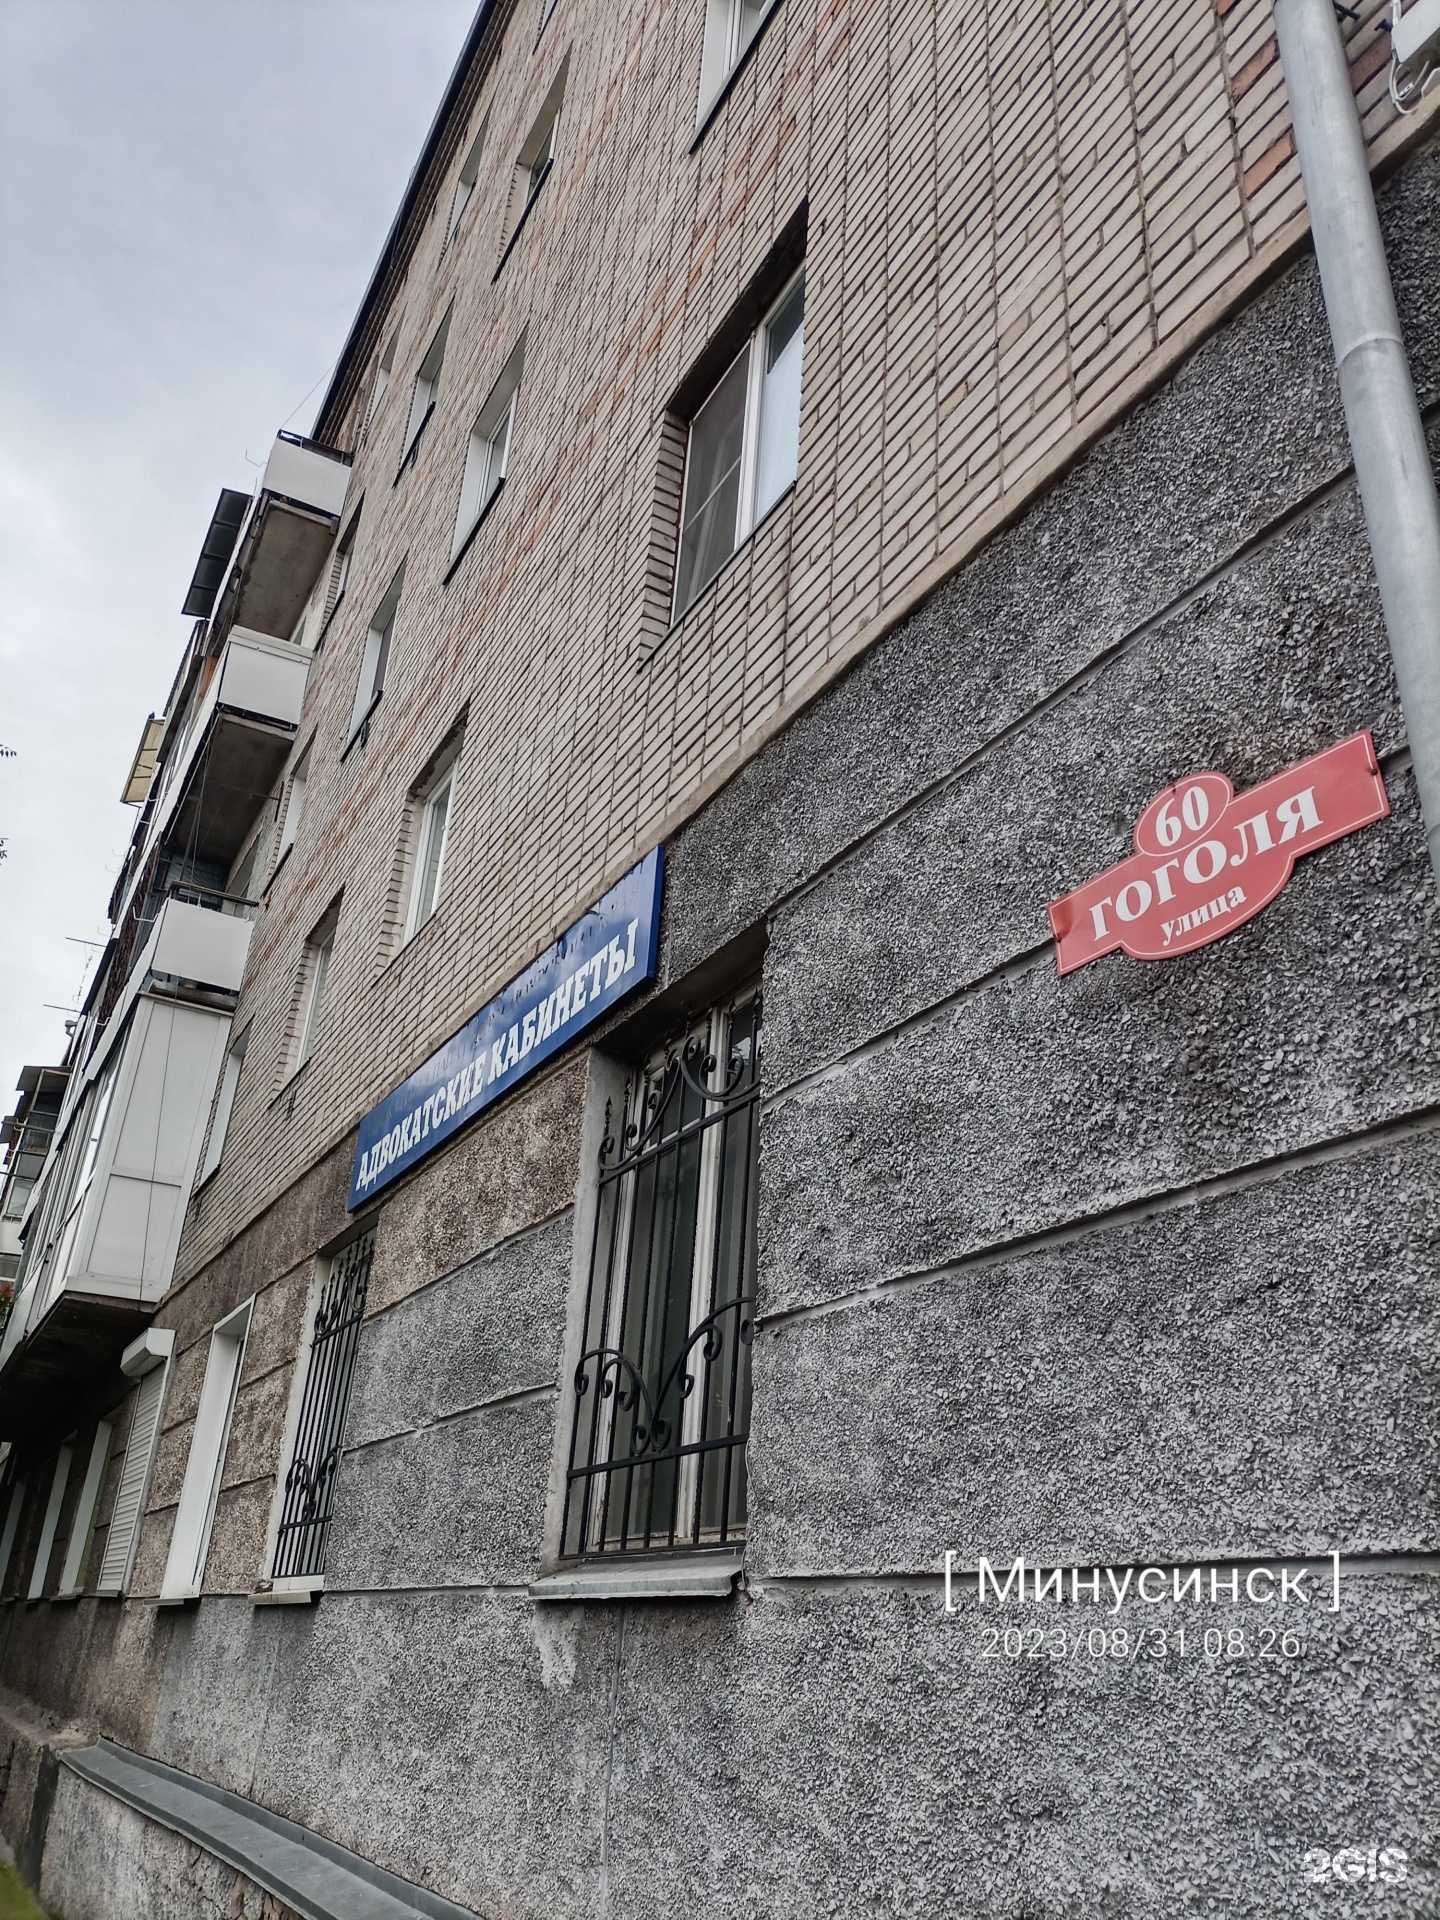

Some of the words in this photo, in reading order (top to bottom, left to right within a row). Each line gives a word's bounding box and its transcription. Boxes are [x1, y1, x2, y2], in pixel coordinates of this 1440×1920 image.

[1088, 785, 1324, 941] ГОГОЛЯ
[1155, 785, 1209, 847] 60
[1160, 885, 1248, 946] улица
[355, 1051, 487, 1192] АДВОКАТСКИЕ
[487, 918, 639, 1086] КАБИНЕТЫ
